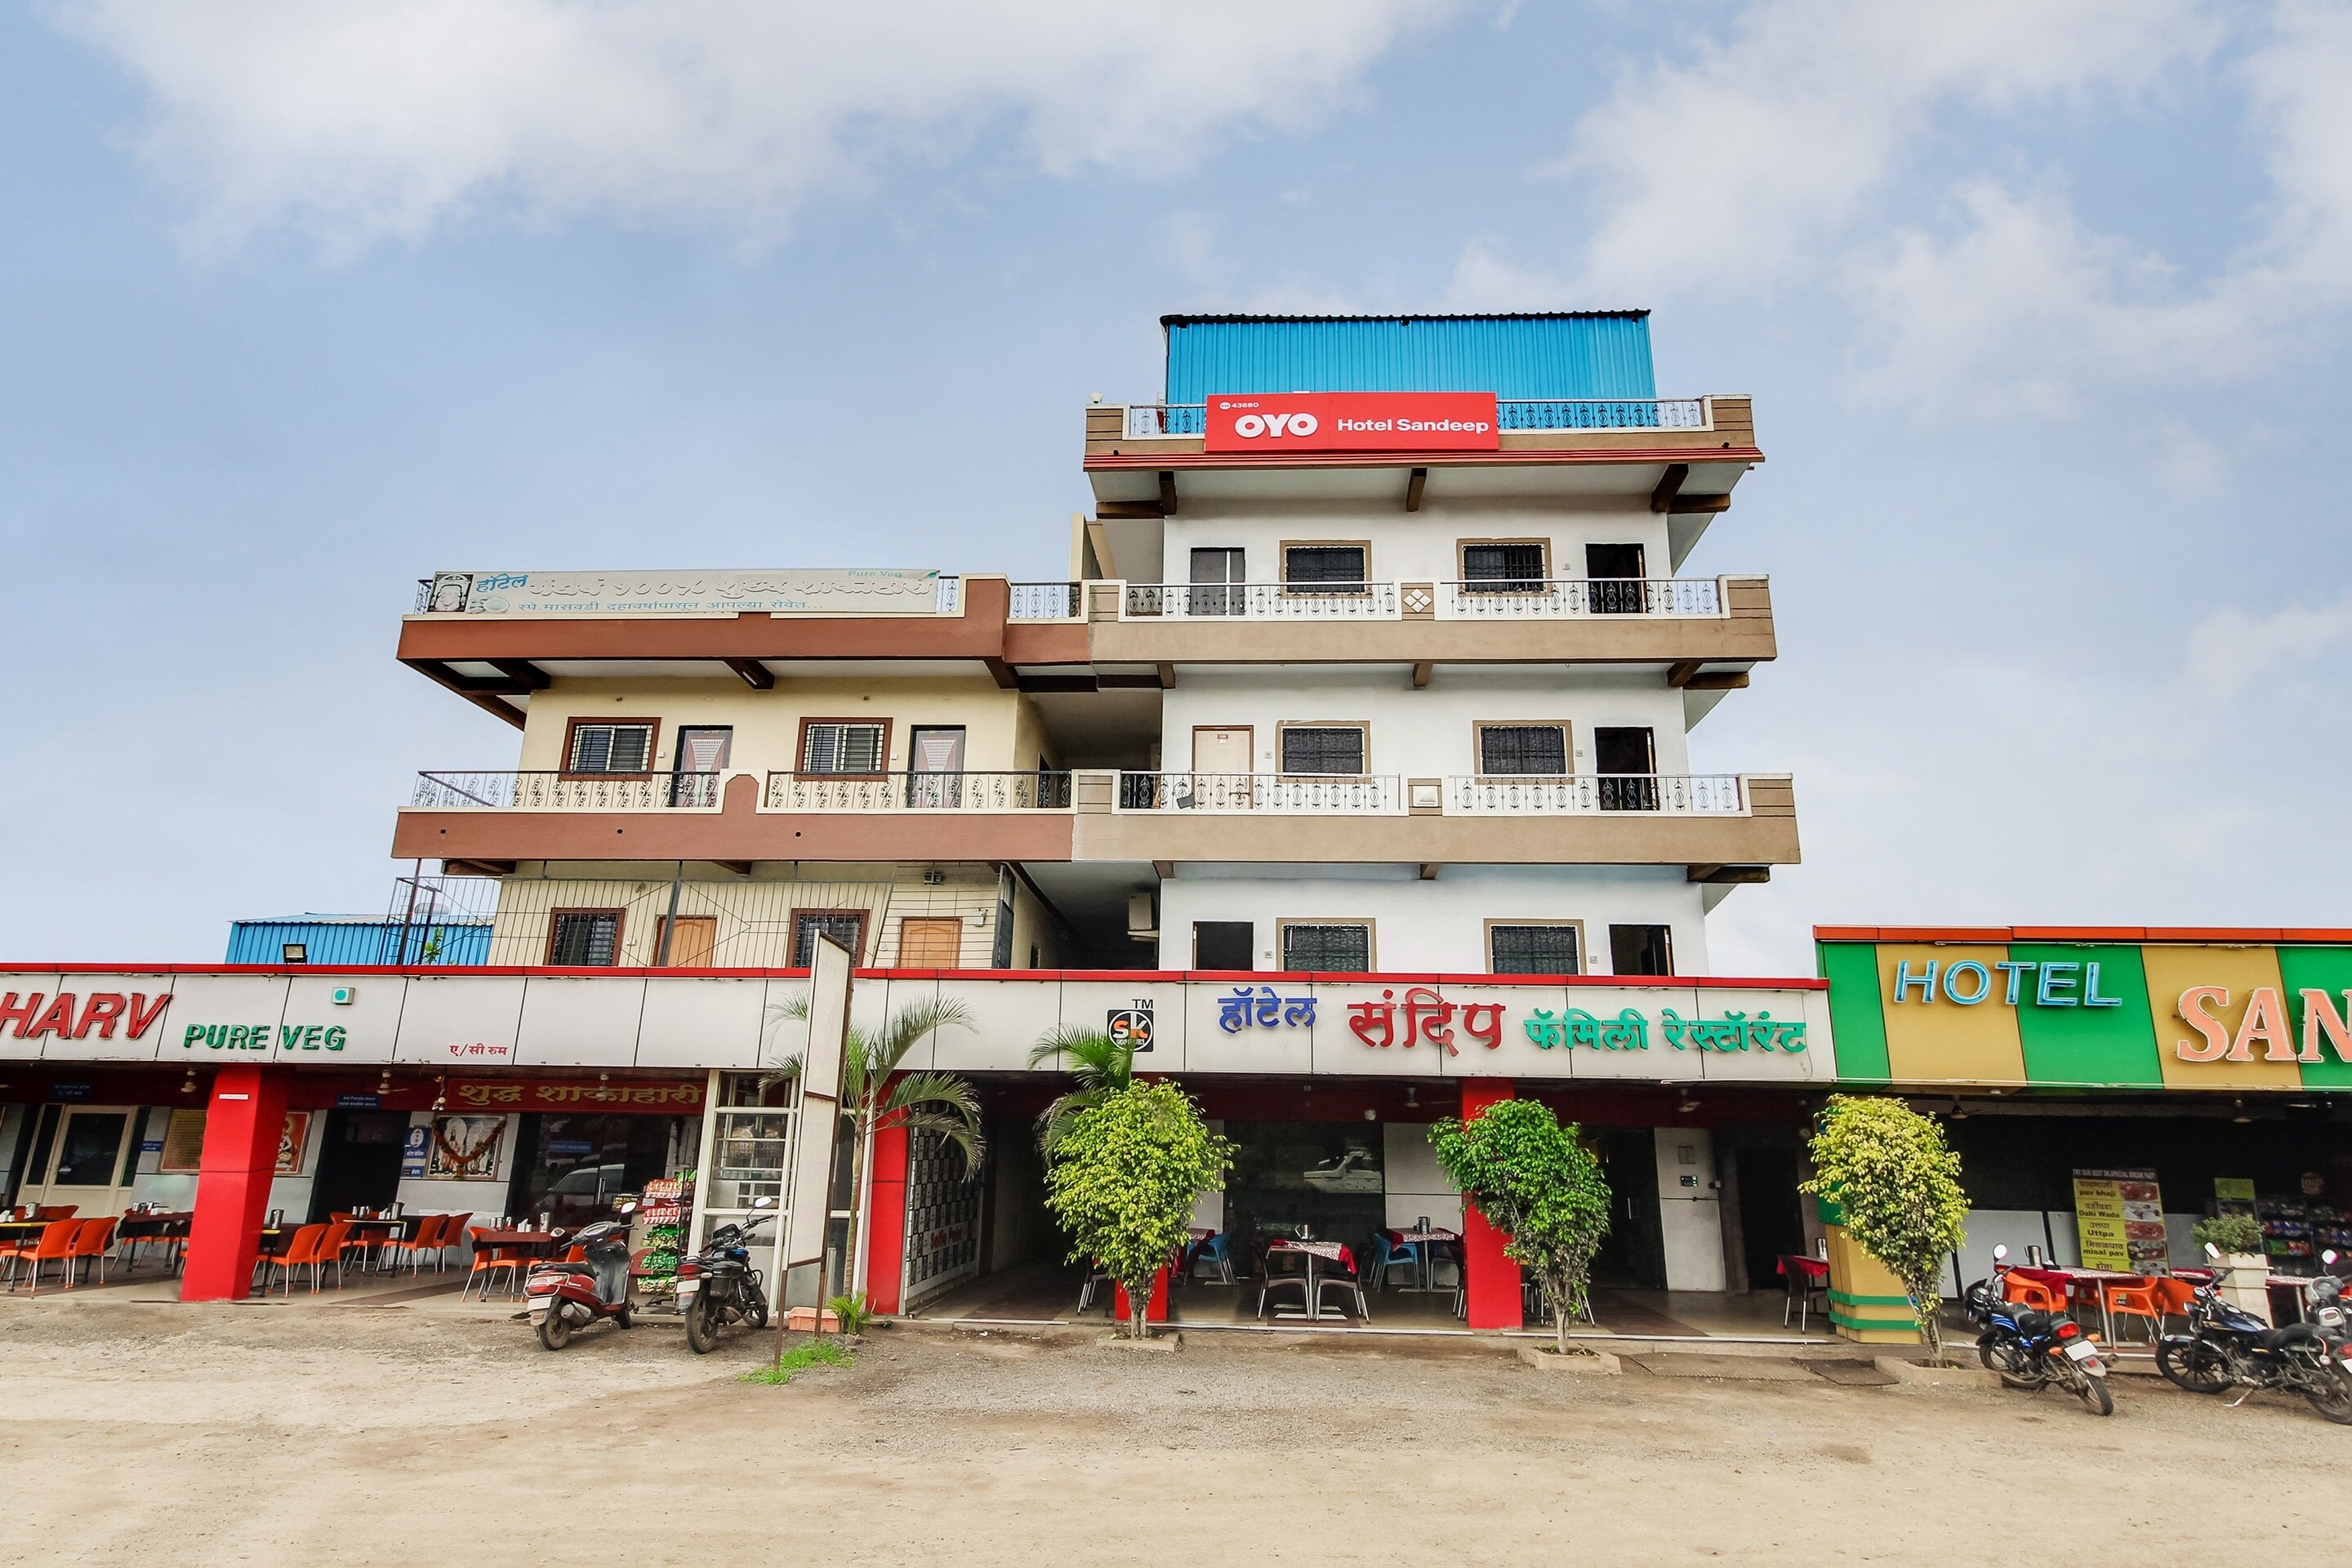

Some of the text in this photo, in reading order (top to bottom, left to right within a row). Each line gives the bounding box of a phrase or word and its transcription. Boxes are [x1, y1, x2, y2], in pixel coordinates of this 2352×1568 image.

[1235, 412, 1319, 439] OYO
[1338, 418, 1490, 434] Hotel Sandeep
[476, 572, 529, 593] हॉटेल
[880, 571, 902, 579] Veg
[706, 600, 763, 611] आपल्या
[1893, 960, 2123, 1007] HOTEL
[1132, 999, 1153, 1009] TM
[0, 992, 173, 1040] HARV
[1218, 987, 1807, 1058] हॉटेल संदिप फॅमिली रेस्टॉरंट
[2176, 985, 2352, 1063] SAN
[183, 1024, 347, 1051] PURE VEG
[458, 1084, 703, 1106] शुद्ध शाकाहारी
[2096, 1189, 2116, 1198] bhaji
[2087, 1229, 2114, 1238] Uttpa
